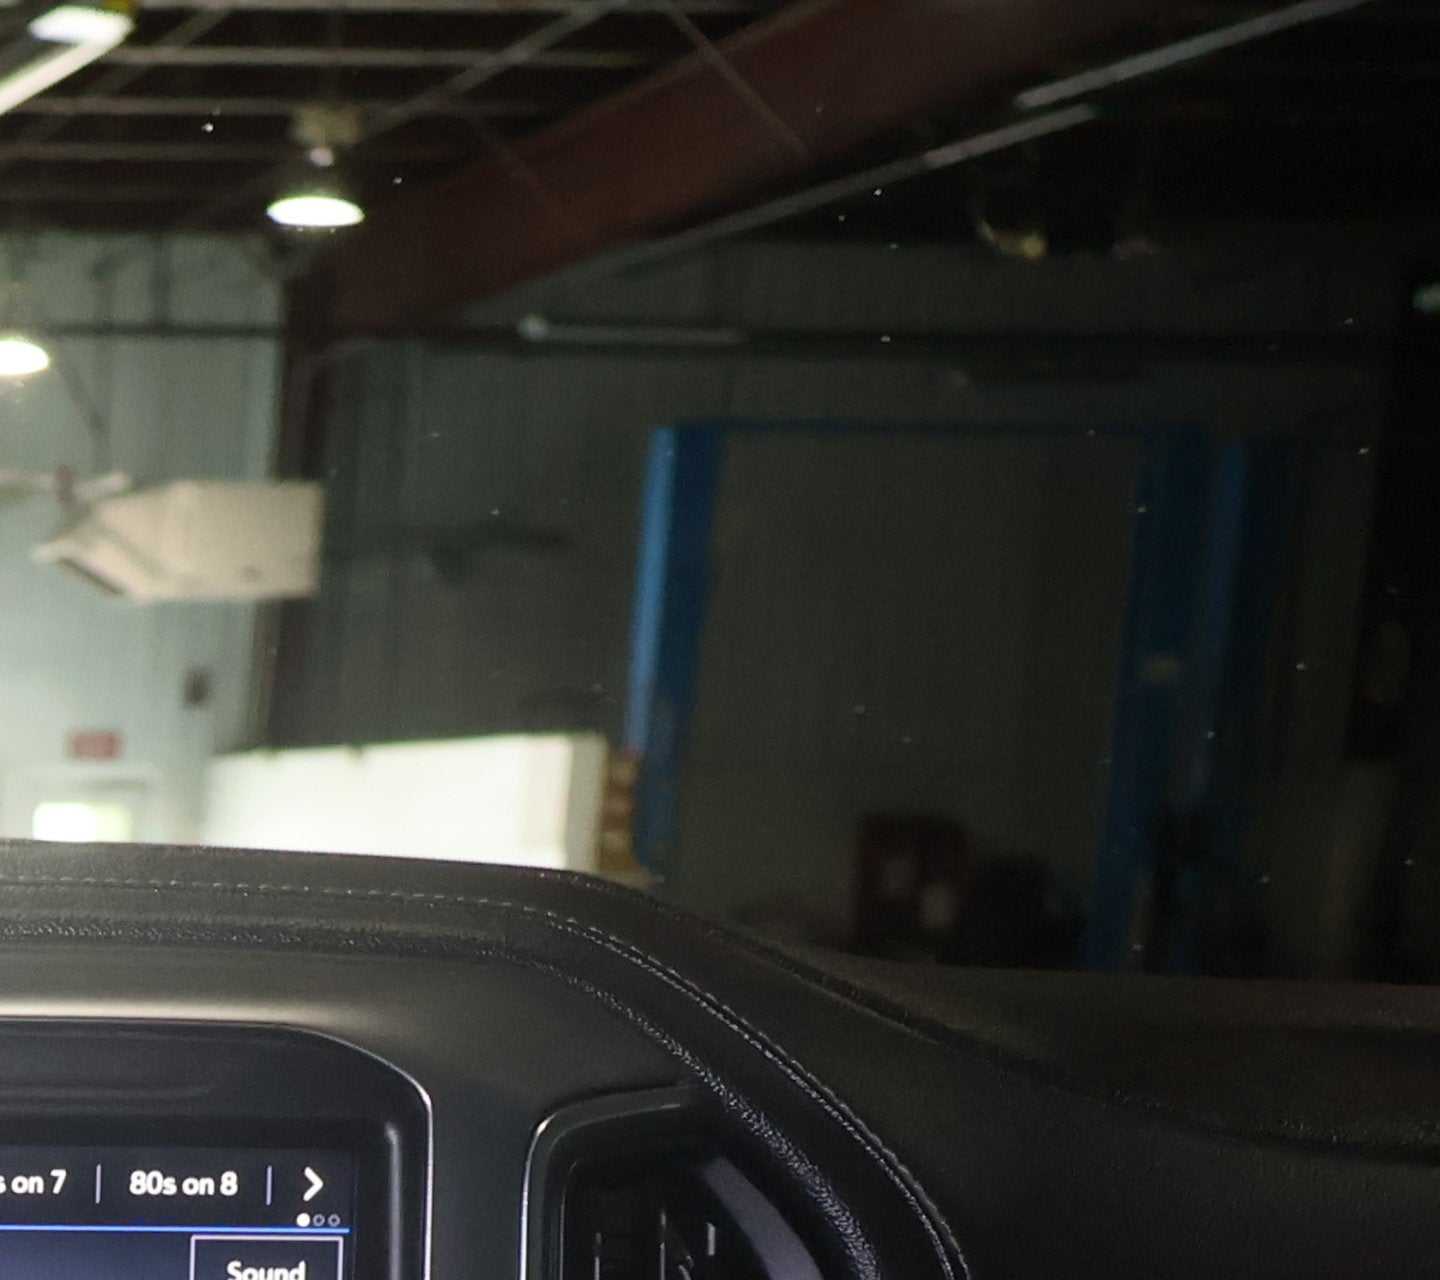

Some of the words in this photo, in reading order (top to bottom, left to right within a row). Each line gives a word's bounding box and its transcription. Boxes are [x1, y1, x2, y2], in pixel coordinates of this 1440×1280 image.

[11, 1175, 42, 1196] on
[49, 1169, 68, 1196] 7
[129, 1170, 177, 1197] 80s
[182, 1177, 215, 1197] on
[218, 1171, 240, 1197] 8
